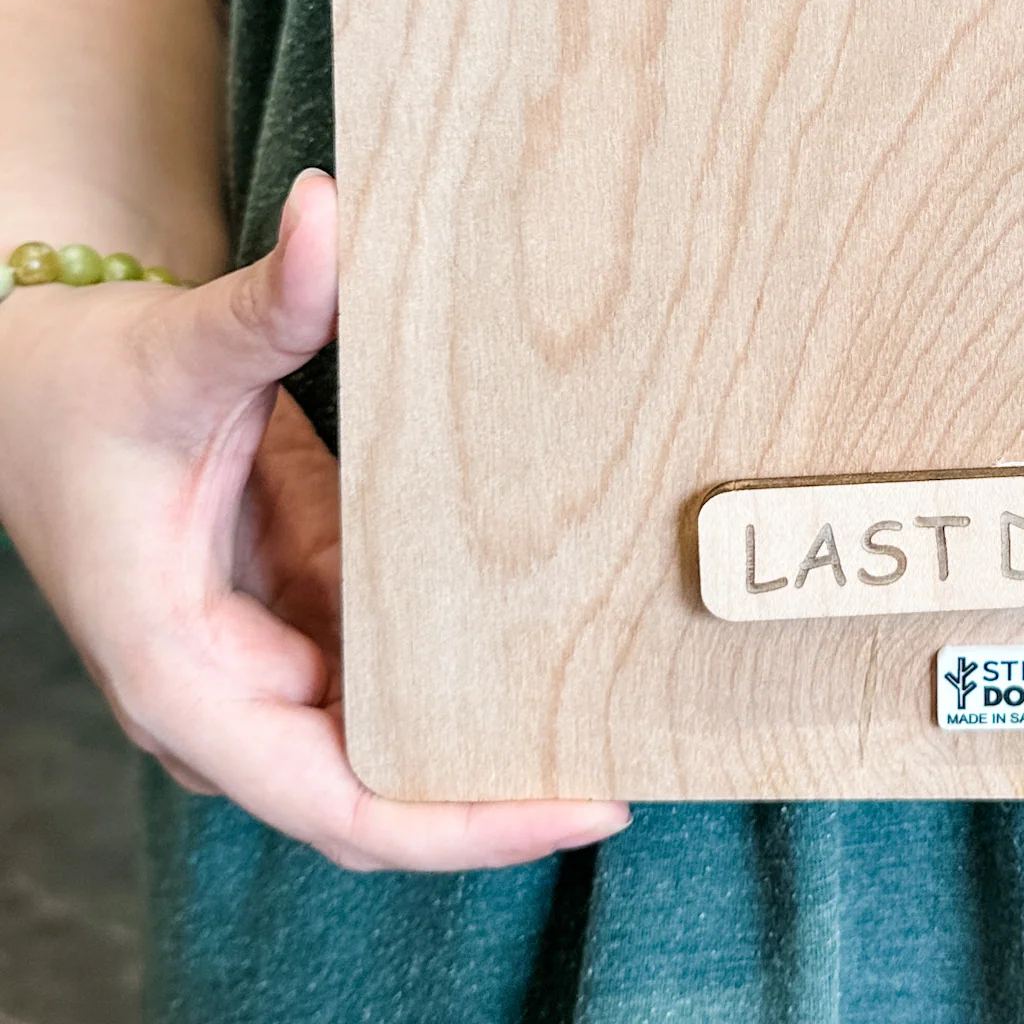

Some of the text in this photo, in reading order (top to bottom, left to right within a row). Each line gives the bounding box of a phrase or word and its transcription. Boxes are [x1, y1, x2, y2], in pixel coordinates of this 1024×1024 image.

[744, 514, 971, 594] LAST
[947, 713, 987, 724] MADE
[992, 713, 1006, 724] IN
